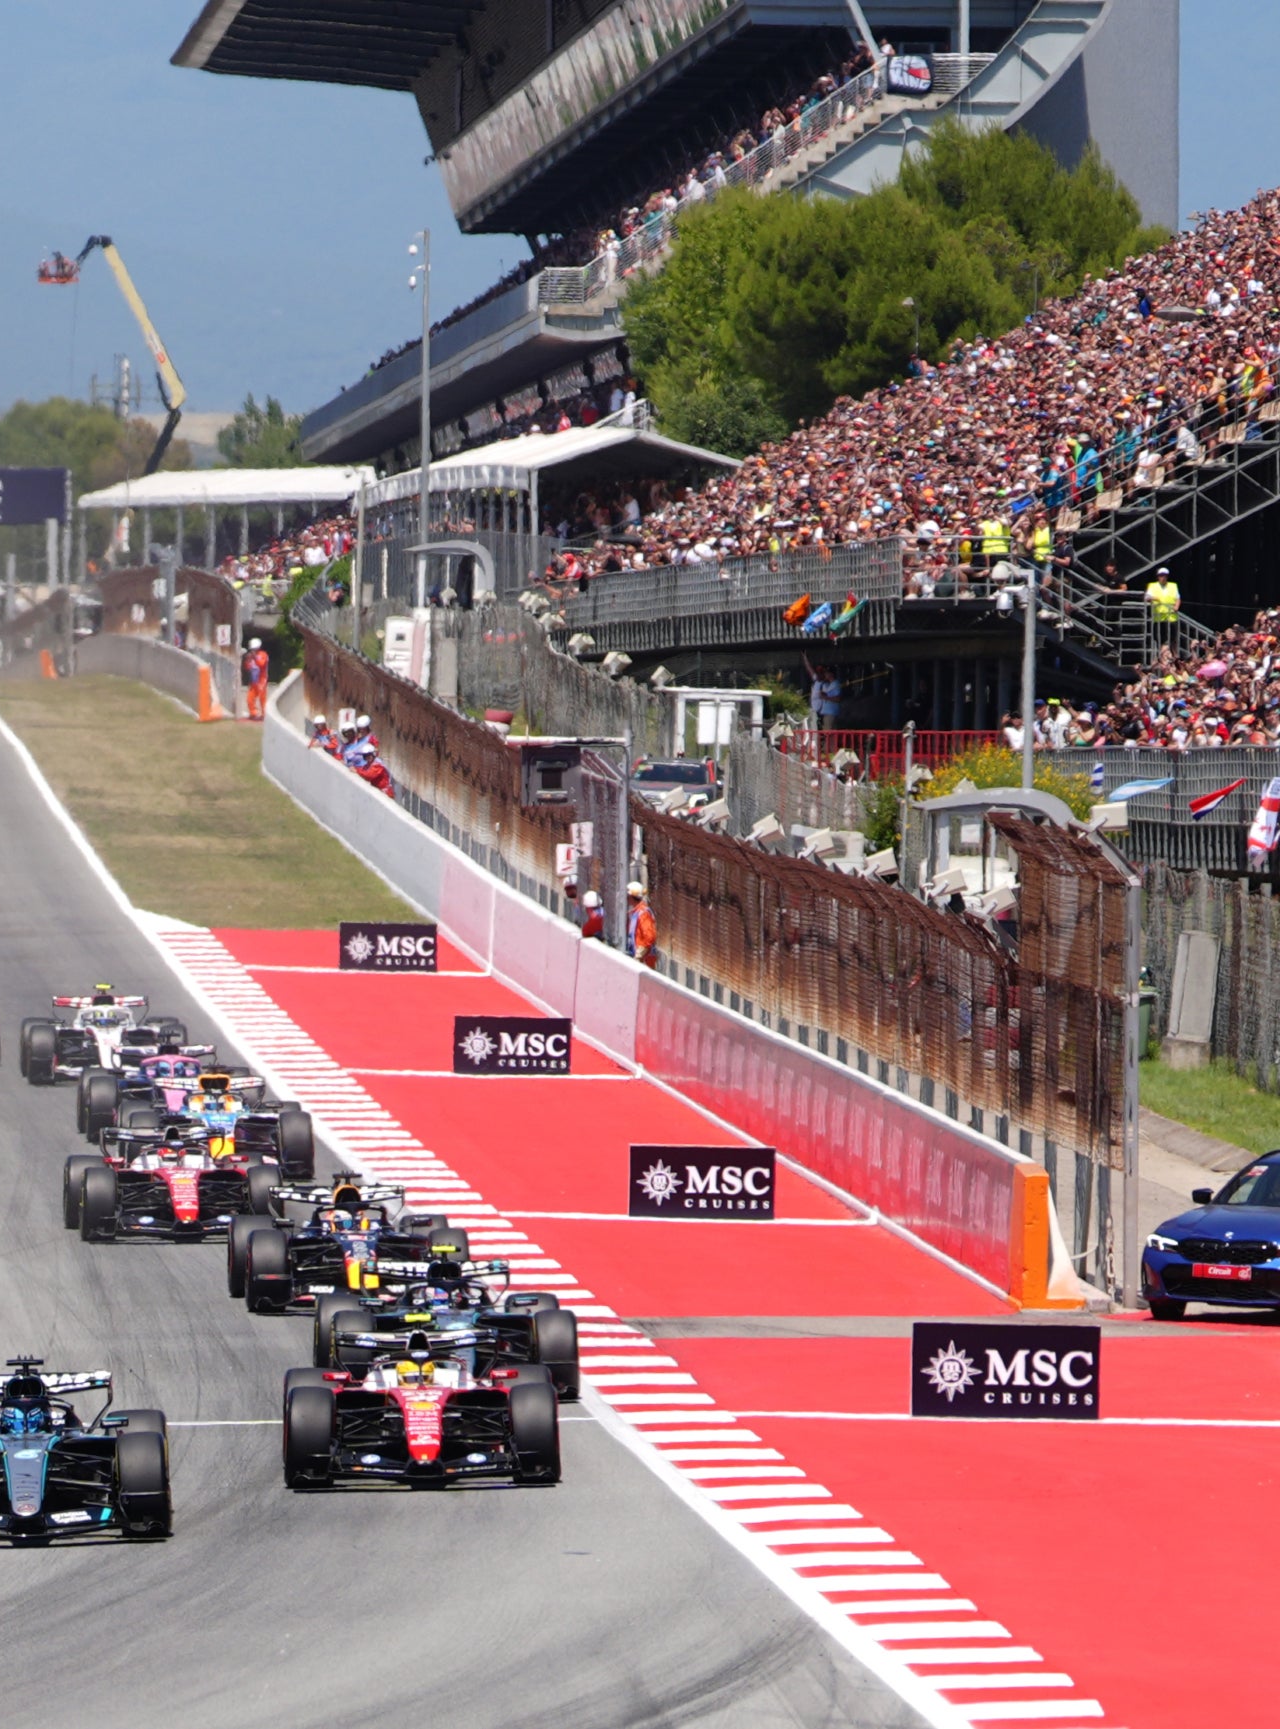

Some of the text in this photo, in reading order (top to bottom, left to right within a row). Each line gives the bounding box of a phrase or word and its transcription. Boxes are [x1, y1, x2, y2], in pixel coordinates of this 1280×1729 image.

[376, 934, 435, 957] MSC
[499, 1032, 568, 1058] MSC
[498, 1058, 568, 1069] CRUISES
[684, 1165, 771, 1196] MSC
[684, 1199, 771, 1210] CRUISES
[1208, 1266, 1232, 1276] Circuit
[984, 1349, 1094, 1388] MSC
[984, 1391, 1094, 1406] CRUISES
